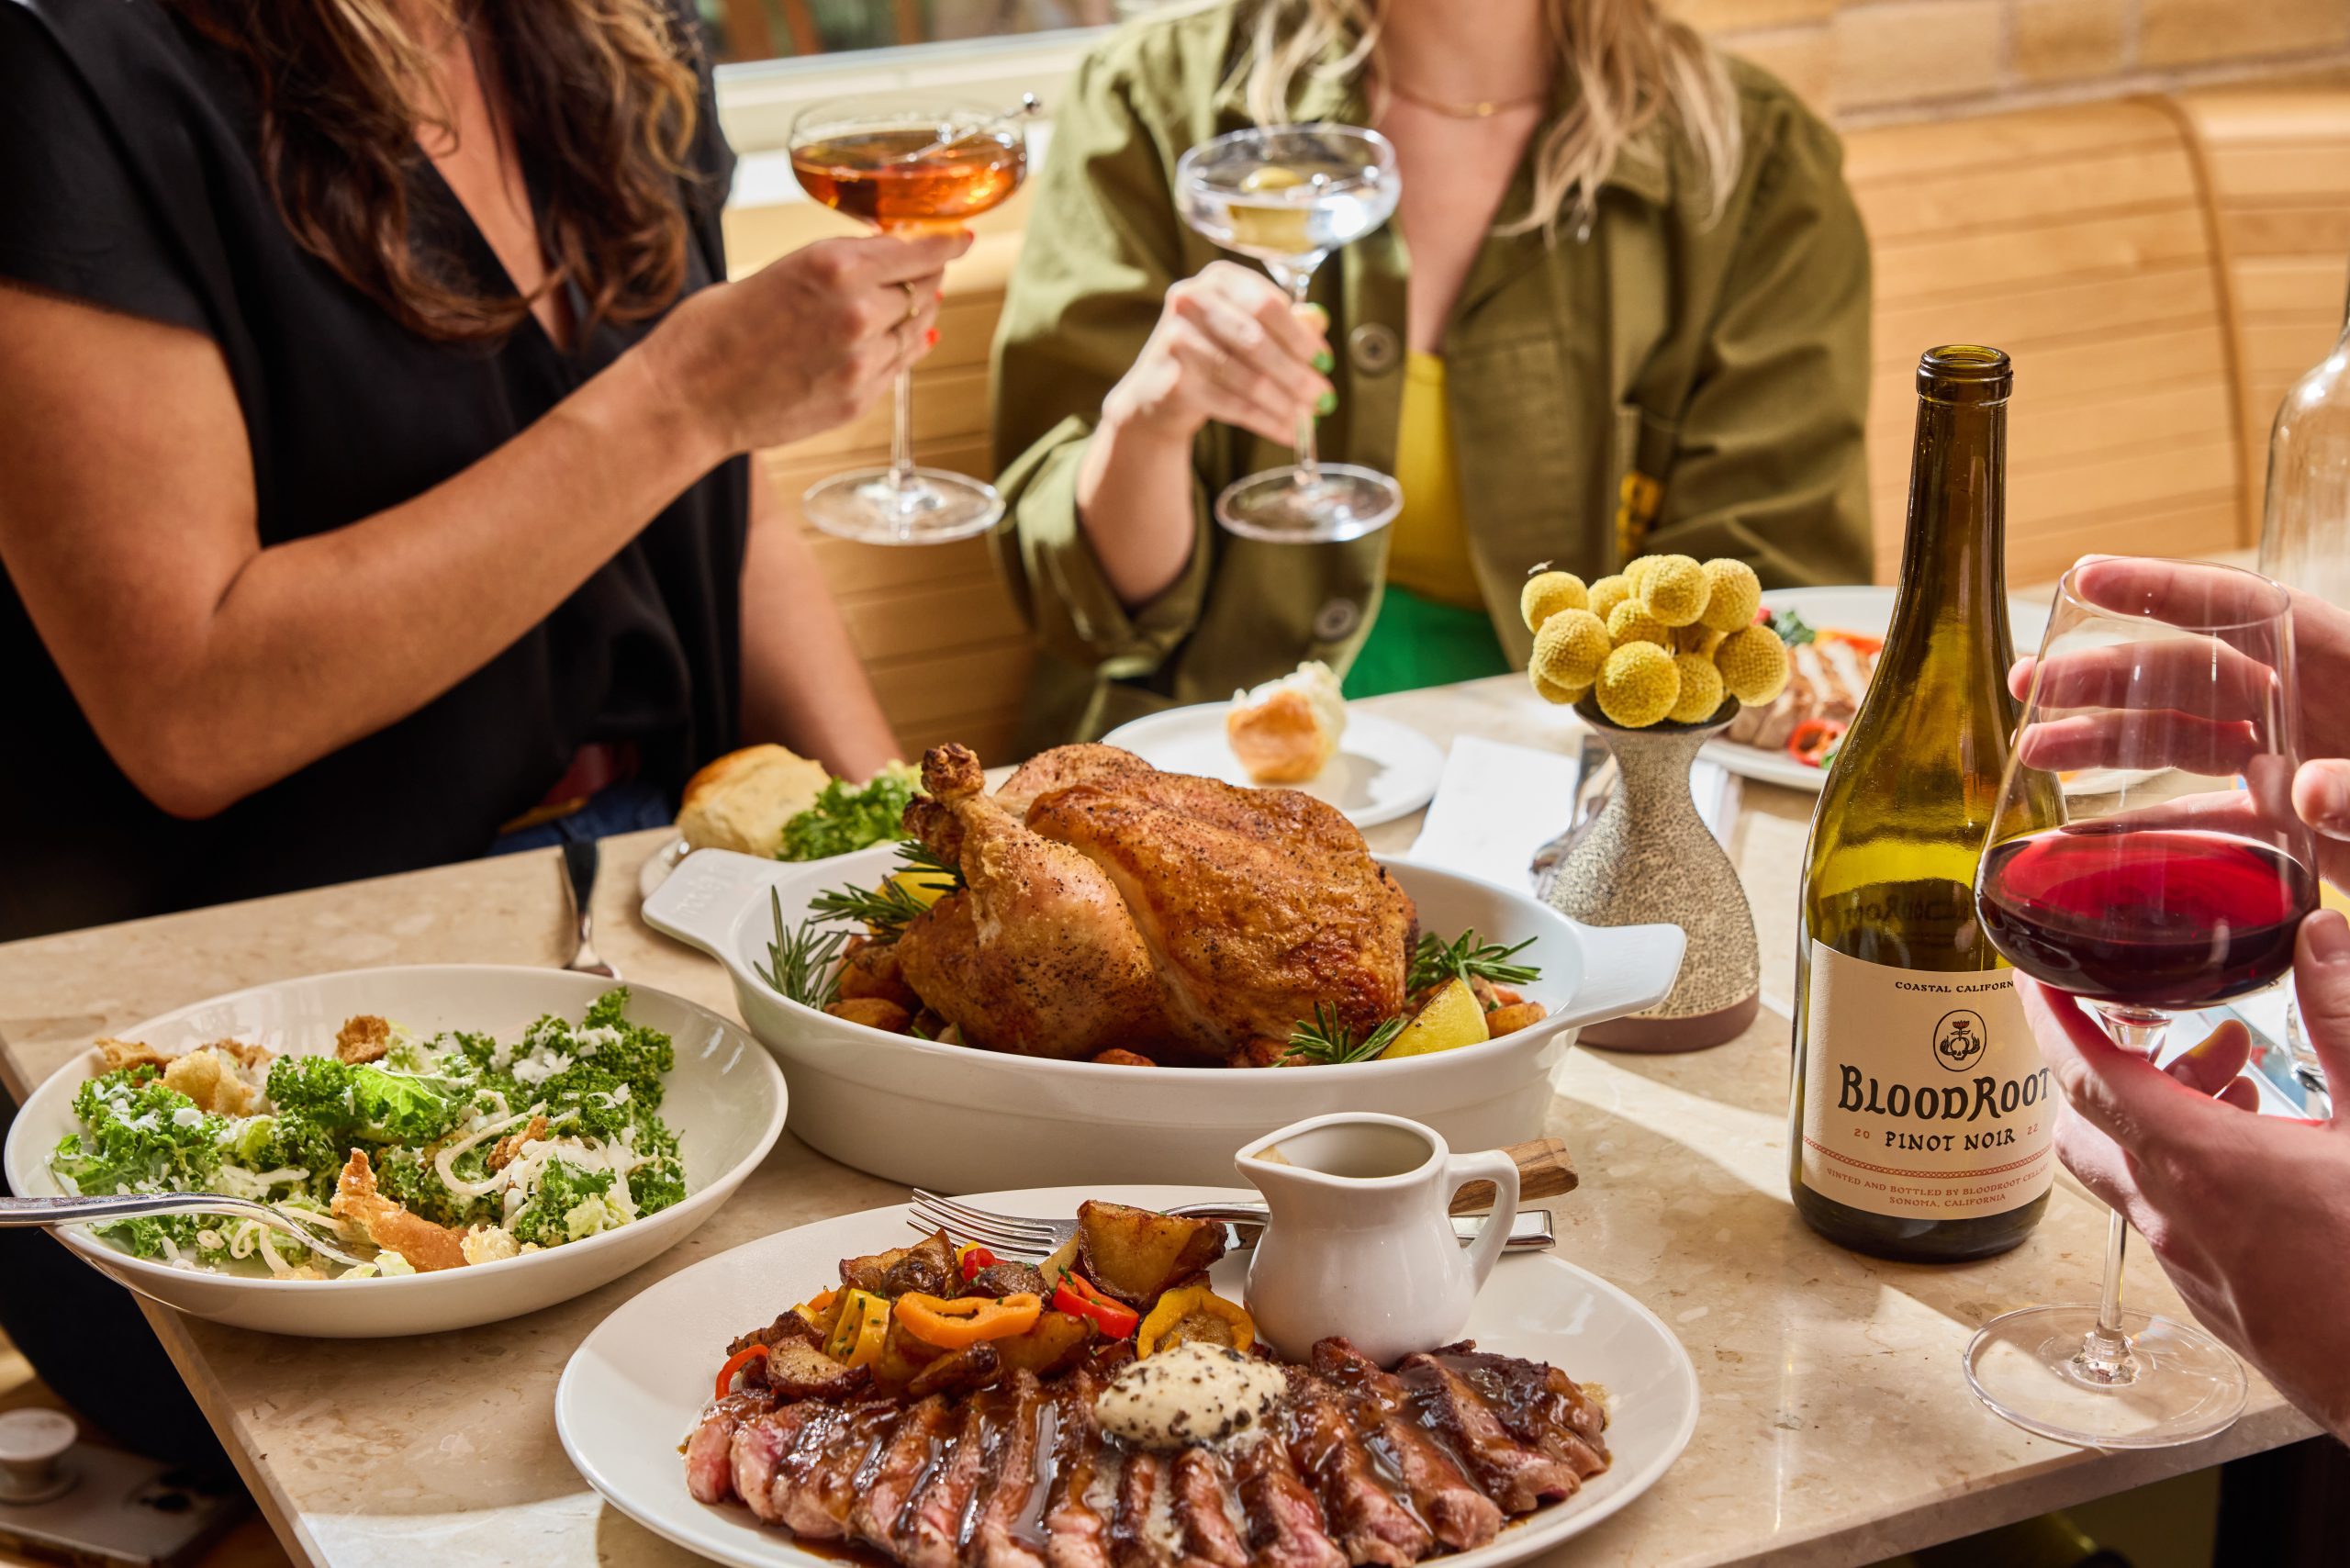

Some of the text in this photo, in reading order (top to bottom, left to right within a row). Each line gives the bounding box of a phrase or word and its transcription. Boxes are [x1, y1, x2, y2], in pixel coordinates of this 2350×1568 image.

[1895, 980, 2014, 992] COASTAL CALIFORN
[1854, 1123, 2039, 1152] 20 PINOT NOIR 22
[1826, 1167, 1862, 1186] VINTED
[1863, 1181, 1886, 1192] AND
[1890, 1185, 1942, 1197] BOTTLED
[1946, 1188, 1959, 1196] BY
[1963, 1178, 2021, 1195] BLOODROOT
[1889, 1193, 2007, 1208] SONOMA, CALIFORNIA
